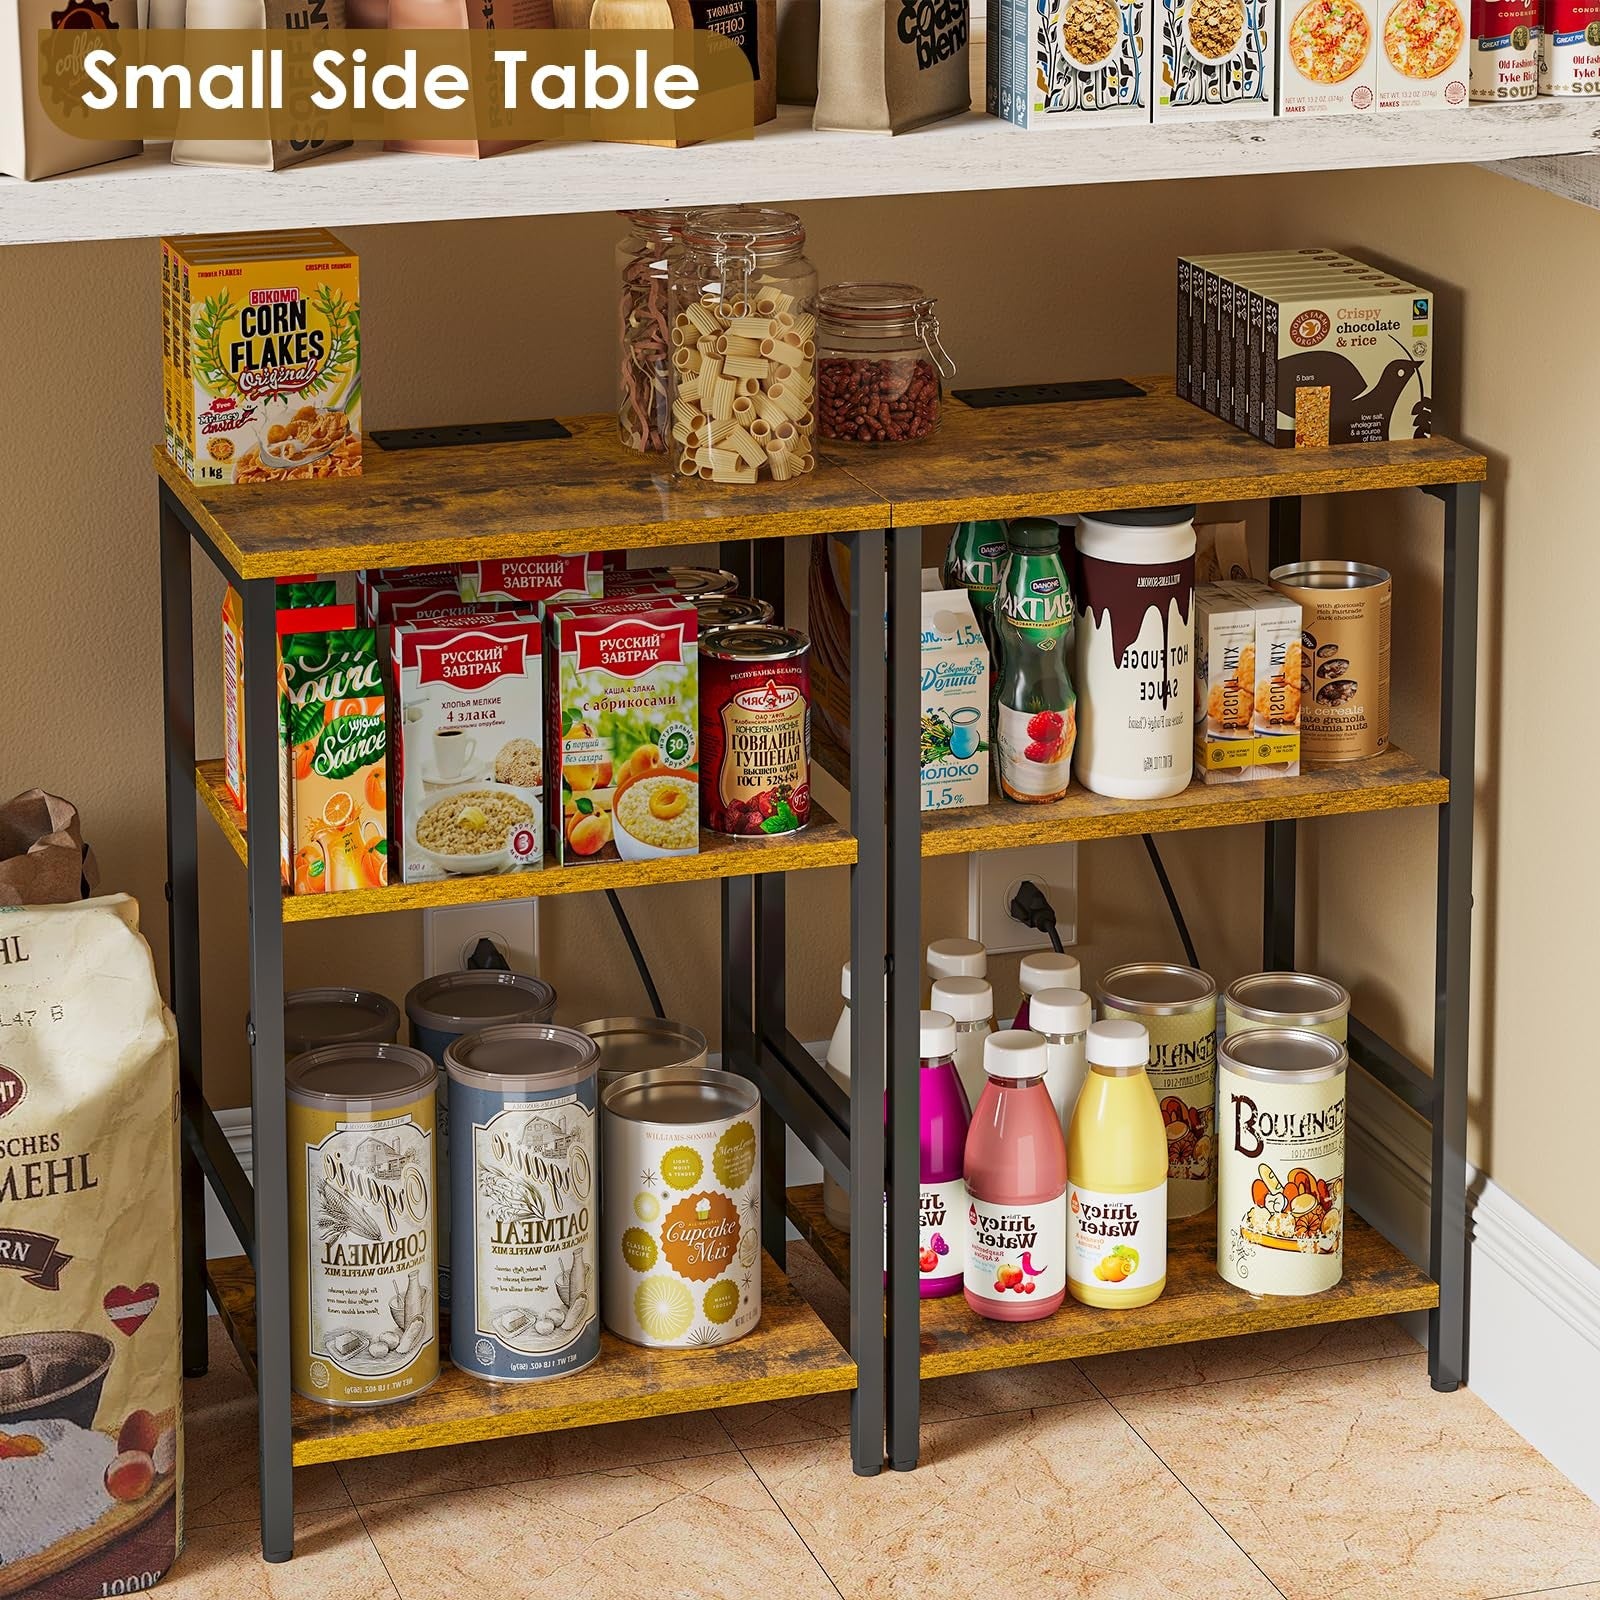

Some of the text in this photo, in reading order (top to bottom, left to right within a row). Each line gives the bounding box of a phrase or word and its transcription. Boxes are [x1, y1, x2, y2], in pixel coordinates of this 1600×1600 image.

[1498, 60, 1510, 69] Old
[1573, 56, 1584, 64] Old
[1498, 72, 1520, 84] Tyke
[1573, 69, 1595, 79] Tyke
[1497, 85, 1536, 98] SOUP
[251, 290, 297, 304] BOKOMO
[241, 299, 306, 338] CORN
[1337, 308, 1381, 321] Crispy
[1337, 321, 1400, 334] chocolate
[1336, 336, 1377, 348] & rice
[231, 330, 324, 373] FLAKES
[238, 358, 318, 397] Original
[1351, 422, 1381, 432] wholegrain
[201, 467, 222, 479] 1 kg
[502, 560, 564, 575] РУССКИЙ
[503, 576, 563, 588] ЗАВТРАК
[1032, 579, 1060, 591] DANONE
[600, 634, 660, 651] РУССКИЙ
[441, 646, 503, 664] РУССКИЙ
[601, 649, 658, 664] ЗАВТРАК
[443, 662, 501, 677] ЗАВТРАК
[632, 685, 655, 693] ЗЛАКА
[442, 697, 501, 709] ХЛОПЬЯ МЕЛКИЕ
[583, 696, 676, 712] с абрикосами
[446, 710, 496, 722] 4 злака
[1315, 705, 1364, 716] cereals
[1323, 713, 1365, 726] granola
[1345, 722, 1368, 732] nuts
[565, 739, 599, 750] 6 порций
[732, 730, 801, 752] ГОВЯДИНА
[315, 731, 386, 775] Source
[565, 753, 603, 764] без сахара
[734, 745, 800, 767] ТУШЕНАЯ
[744, 766, 777, 775] высшего
[737, 775, 762, 787] ГОСТ
[926, 788, 965, 808] 1,5%
[517, 833, 529, 852] 3
[408, 863, 420, 871] 400
[666, 1218, 736, 1247] Cupcake
[687, 1240, 730, 1265] Mix
